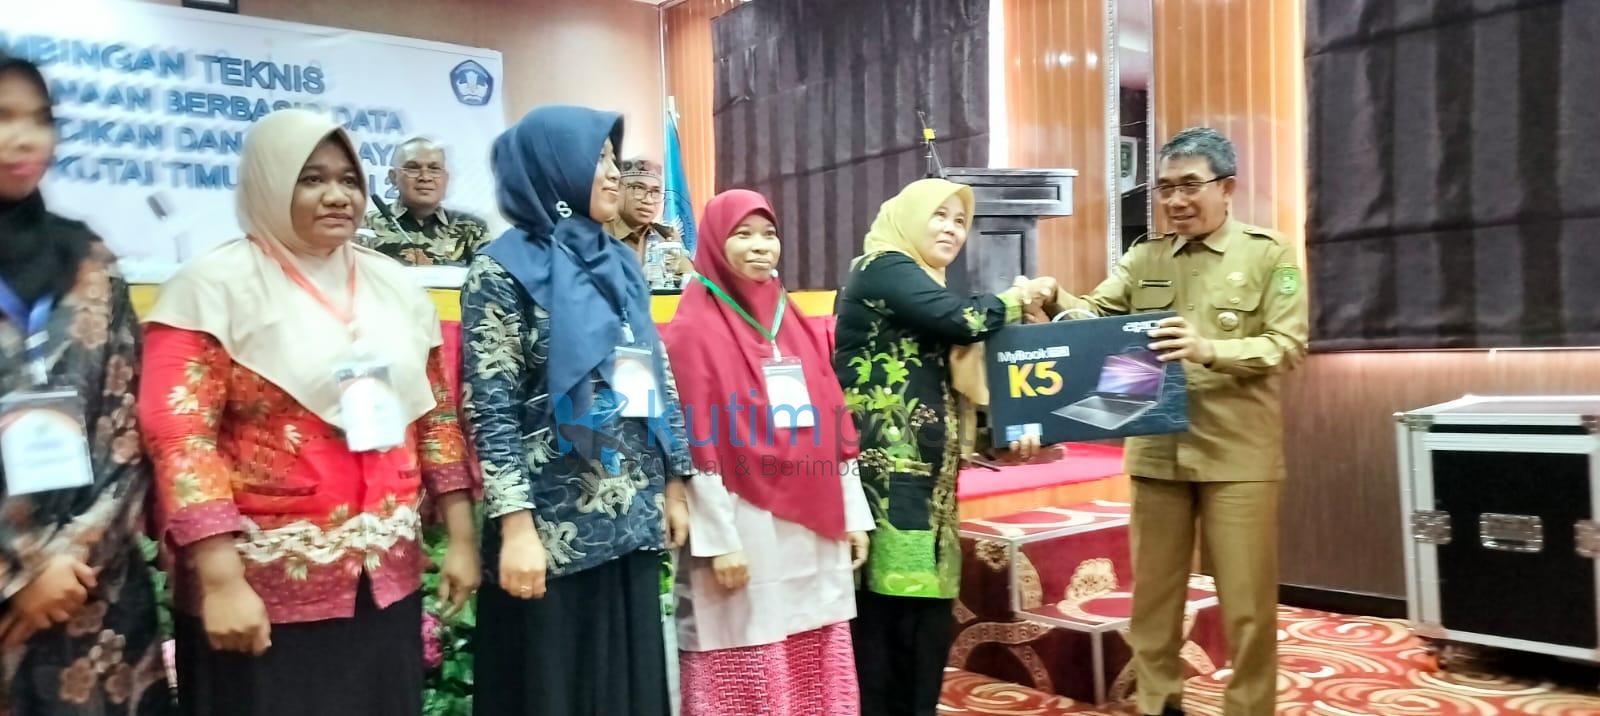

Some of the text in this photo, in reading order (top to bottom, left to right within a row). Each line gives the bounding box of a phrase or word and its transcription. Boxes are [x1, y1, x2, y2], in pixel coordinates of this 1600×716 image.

[195, 54, 325, 95] TEKNIS
[332, 105, 404, 133] DATA
[175, 125, 244, 156] DAN
[162, 161, 241, 191] TIMU
[1008, 361, 1063, 398] K5
